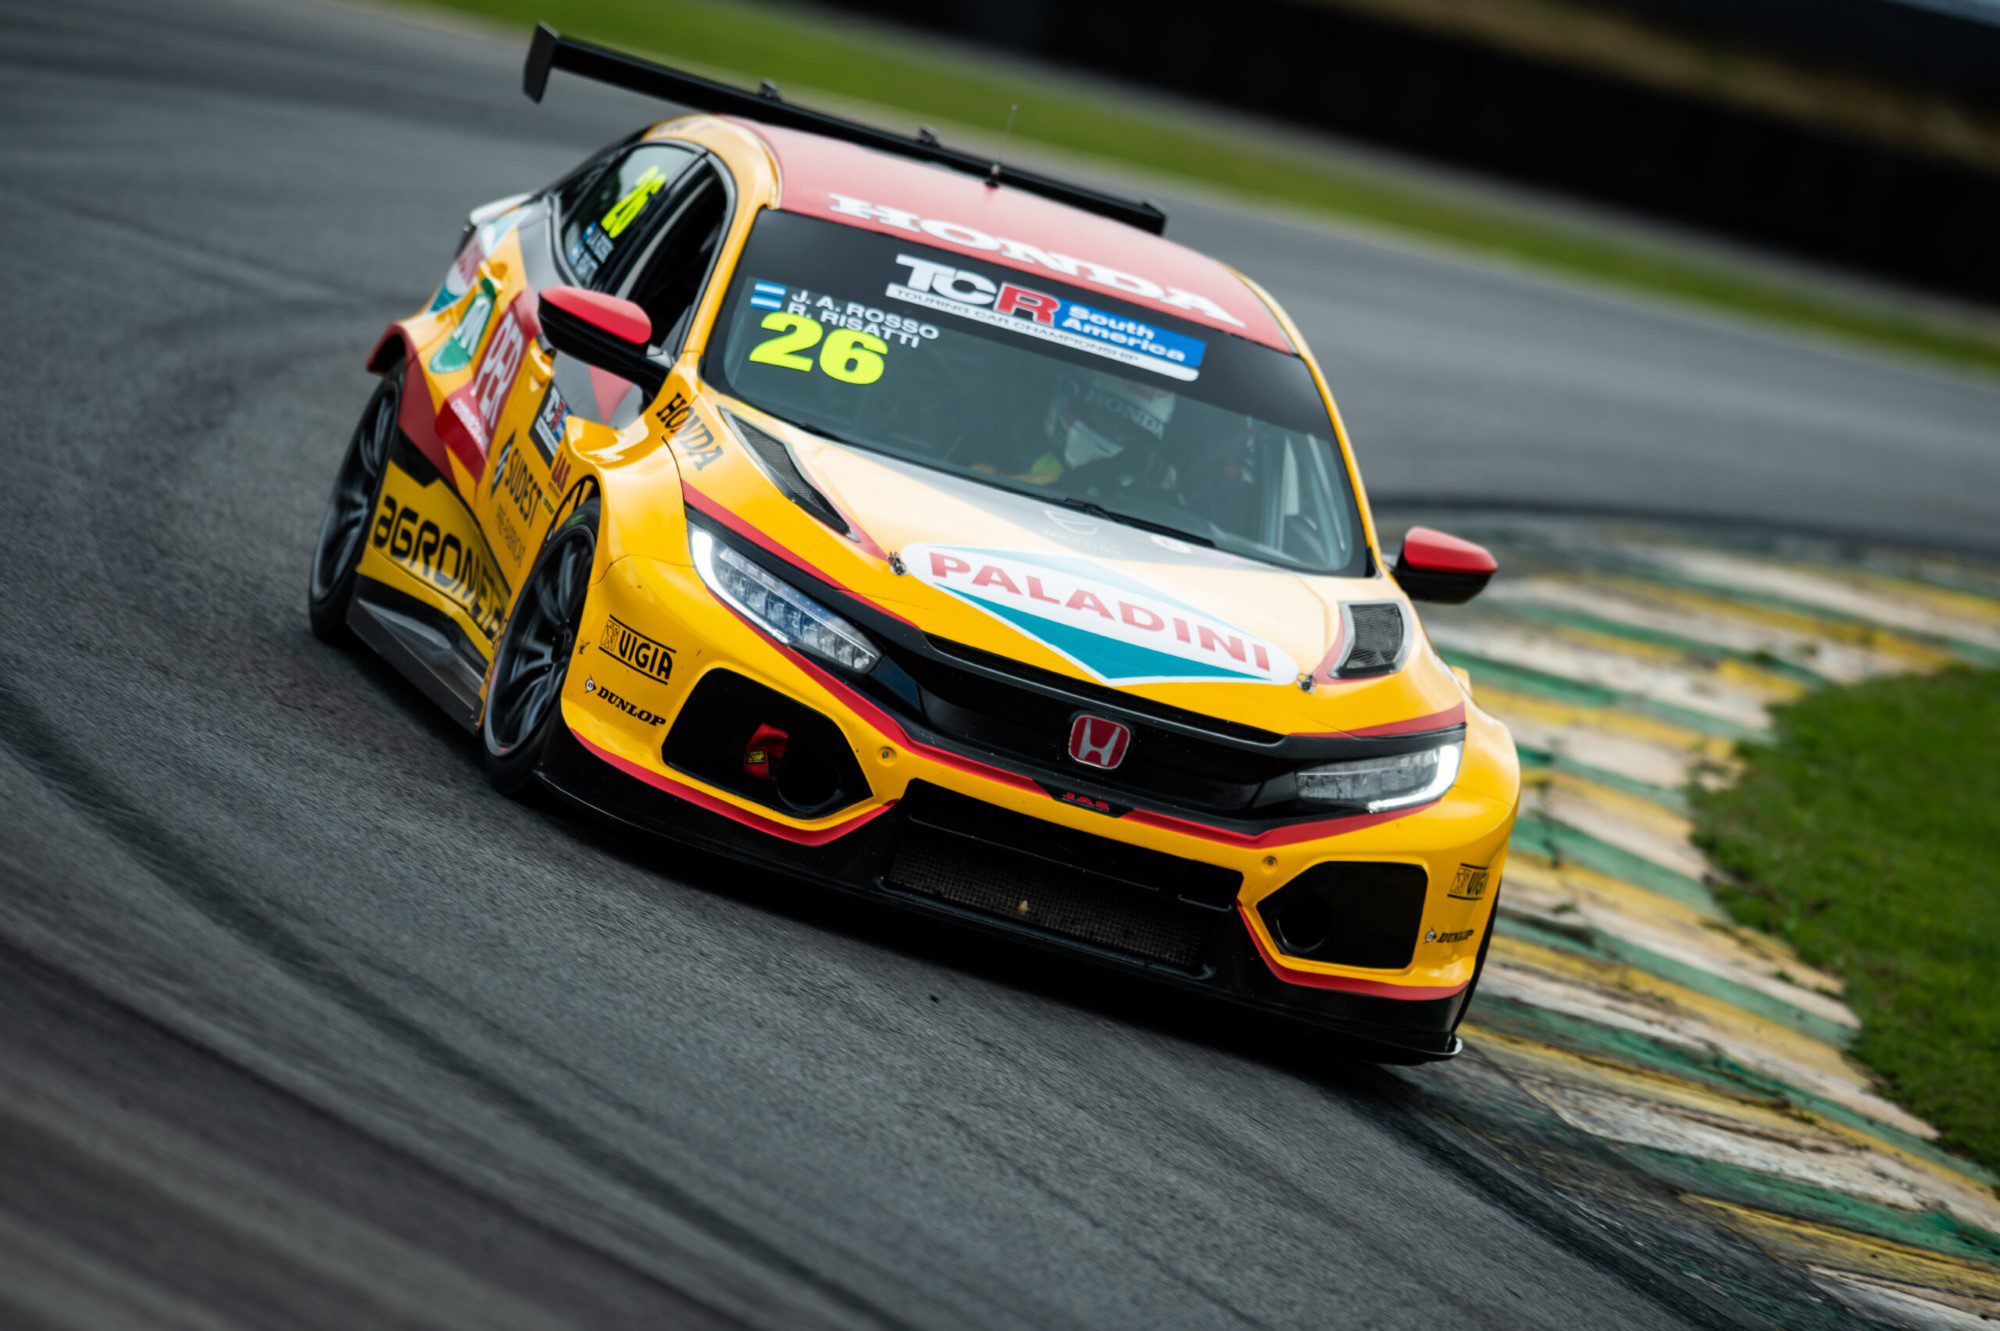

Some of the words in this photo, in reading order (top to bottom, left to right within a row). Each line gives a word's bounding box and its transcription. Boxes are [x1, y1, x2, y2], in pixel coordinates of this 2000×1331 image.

[826, 192, 1247, 329] HONDA
[895, 254, 1060, 328] TCR
[791, 289, 812, 305] J.
[815, 295, 842, 313] A.
[845, 302, 940, 340] ROSSO
[820, 310, 921, 349] RISATTI
[896, 289, 970, 315] TOURING
[974, 310, 1010, 324] CAR
[1012, 321, 1142, 361] CHAMPIONSHIP
[1061, 317, 1186, 363] America
[1067, 305, 1155, 341] South
[749, 311, 888, 385] 26
[655, 392, 725, 472] HONDA
[929, 551, 1272, 673] PALADINI
[619, 630, 674, 680] VIGIA
[597, 686, 667, 727] DUNLOP
